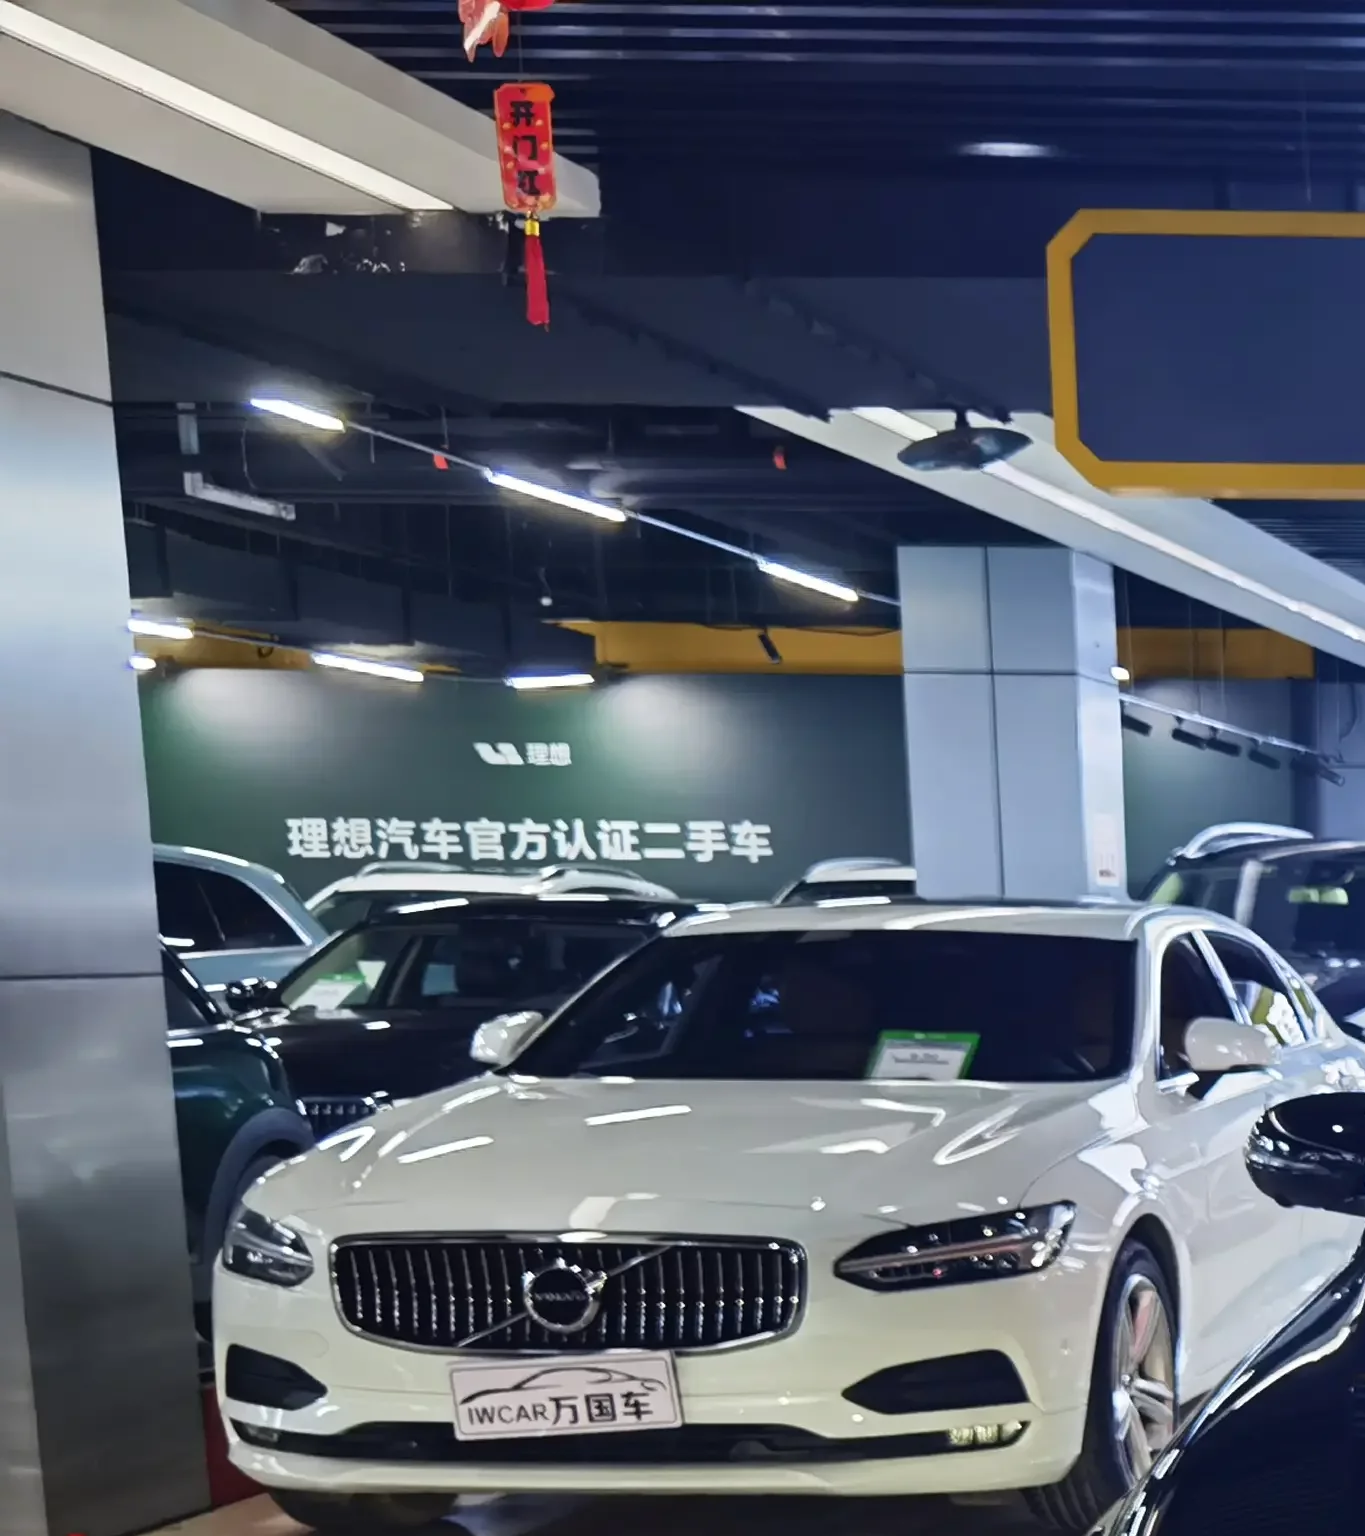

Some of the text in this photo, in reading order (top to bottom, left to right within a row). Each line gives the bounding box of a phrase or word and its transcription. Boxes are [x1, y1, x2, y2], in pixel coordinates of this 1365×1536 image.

[510, 101, 541, 196] 开门红
[525, 741, 572, 766] 理想
[285, 817, 774, 863] 理想汽车官方认证二手车
